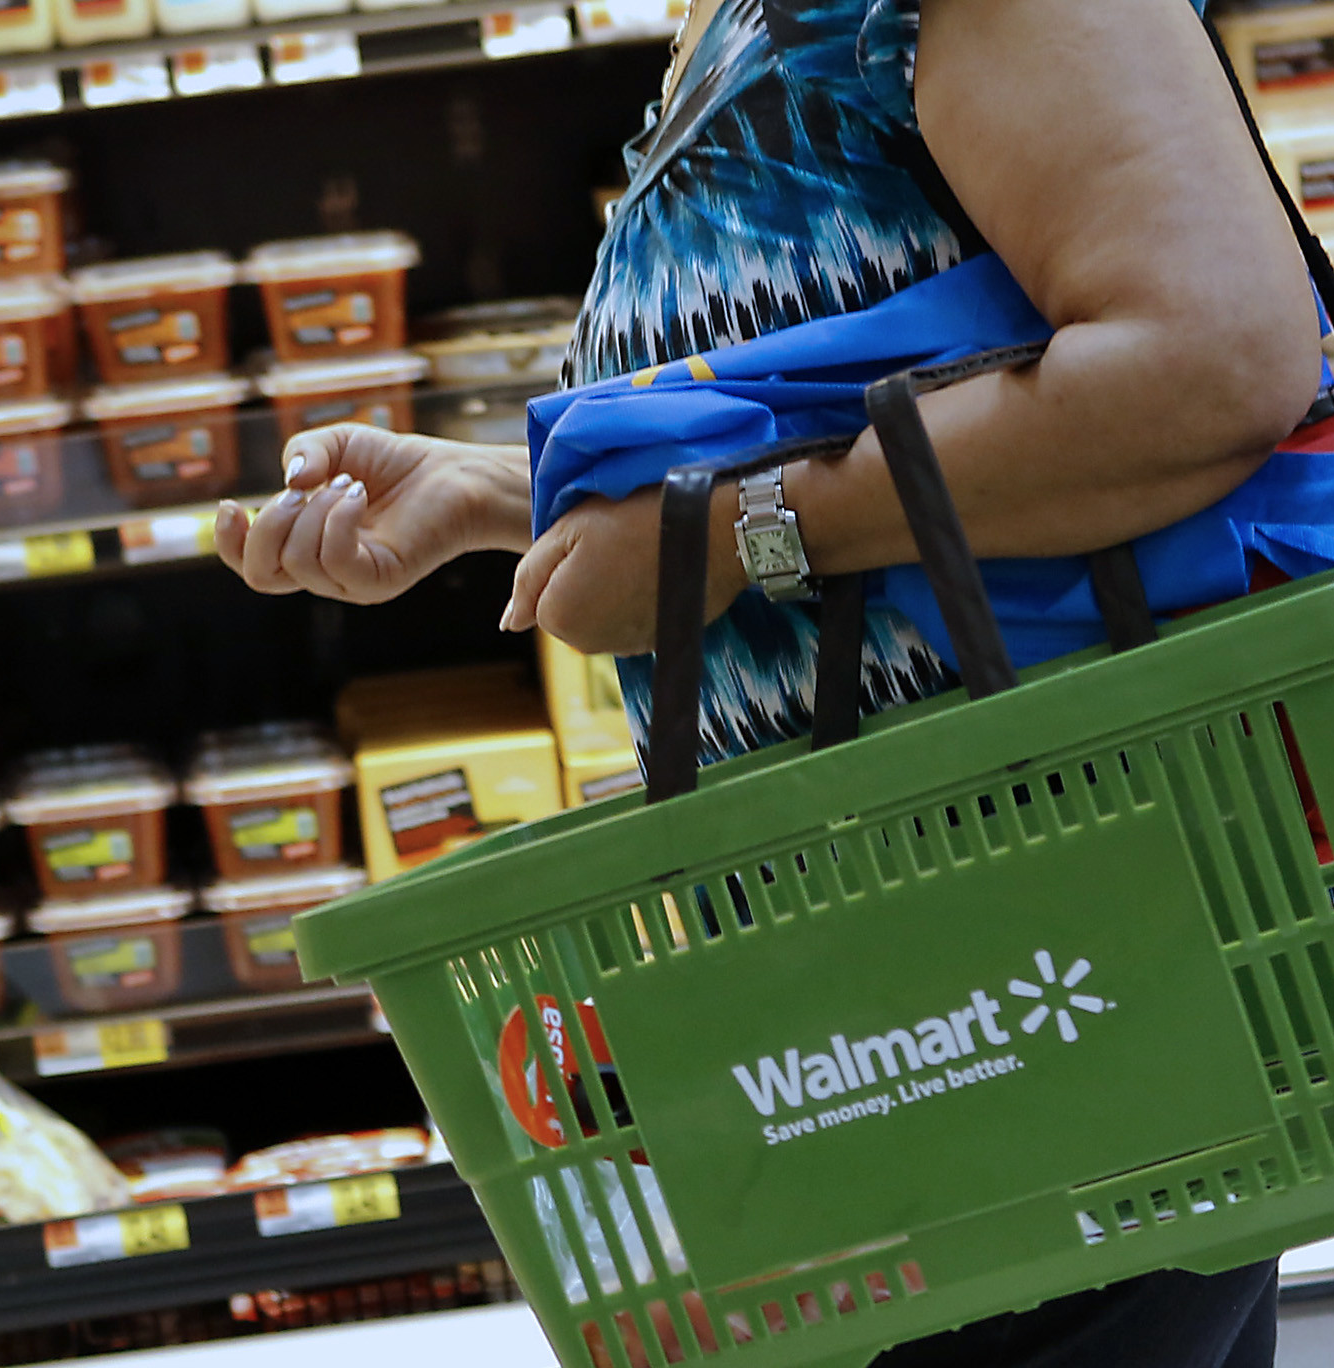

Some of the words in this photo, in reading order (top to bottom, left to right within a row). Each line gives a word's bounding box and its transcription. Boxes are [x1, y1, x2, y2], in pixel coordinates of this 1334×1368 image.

[731, 989, 1011, 1117] Walmart
[763, 1117, 816, 1146] Save
[816, 1092, 898, 1129] money.
[896, 1077, 946, 1104] Live
[945, 1054, 1025, 1089] better.
